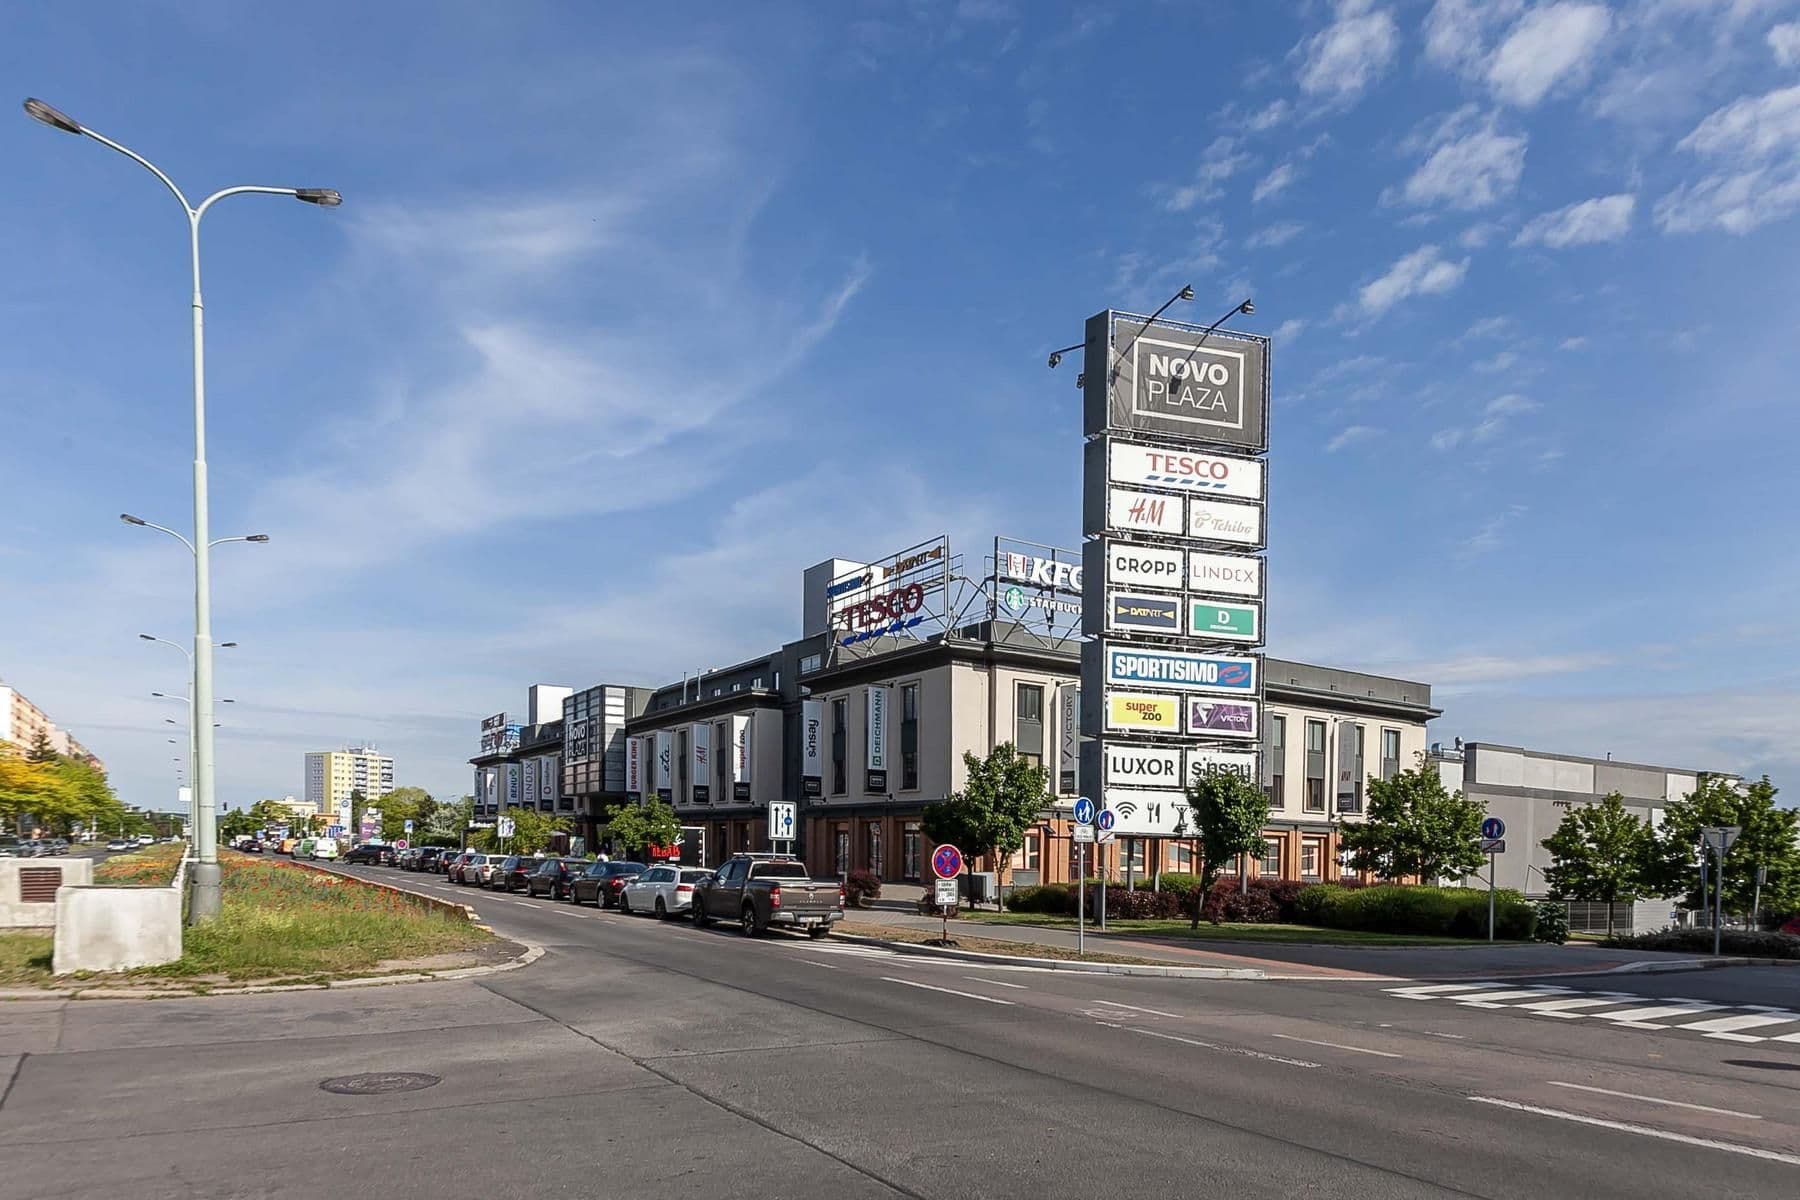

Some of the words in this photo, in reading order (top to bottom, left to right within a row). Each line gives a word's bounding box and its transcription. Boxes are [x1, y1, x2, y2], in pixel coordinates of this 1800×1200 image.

[1149, 353, 1229, 386] NOVO
[1149, 380, 1228, 412] PLAZA
[1146, 453, 1229, 480] TESCO
[1128, 497, 1166, 527] H&M
[1211, 518, 1254, 535] Tchibo
[1116, 556, 1177, 576] CROPP
[1193, 565, 1254, 583] LINDEX
[841, 583, 924, 632] TESCO
[1217, 610, 1230, 624] D
[1115, 655, 1218, 683] SPORTISIMO
[1065, 695, 1073, 747] VICTORY
[1126, 702, 1158, 713] super
[1141, 712, 1162, 722] zoo
[569, 726, 586, 741] NOVO
[805, 719, 819, 758] sinsay
[1112, 757, 1175, 776] LUXOR
[525, 762, 533, 801] LINDEX
